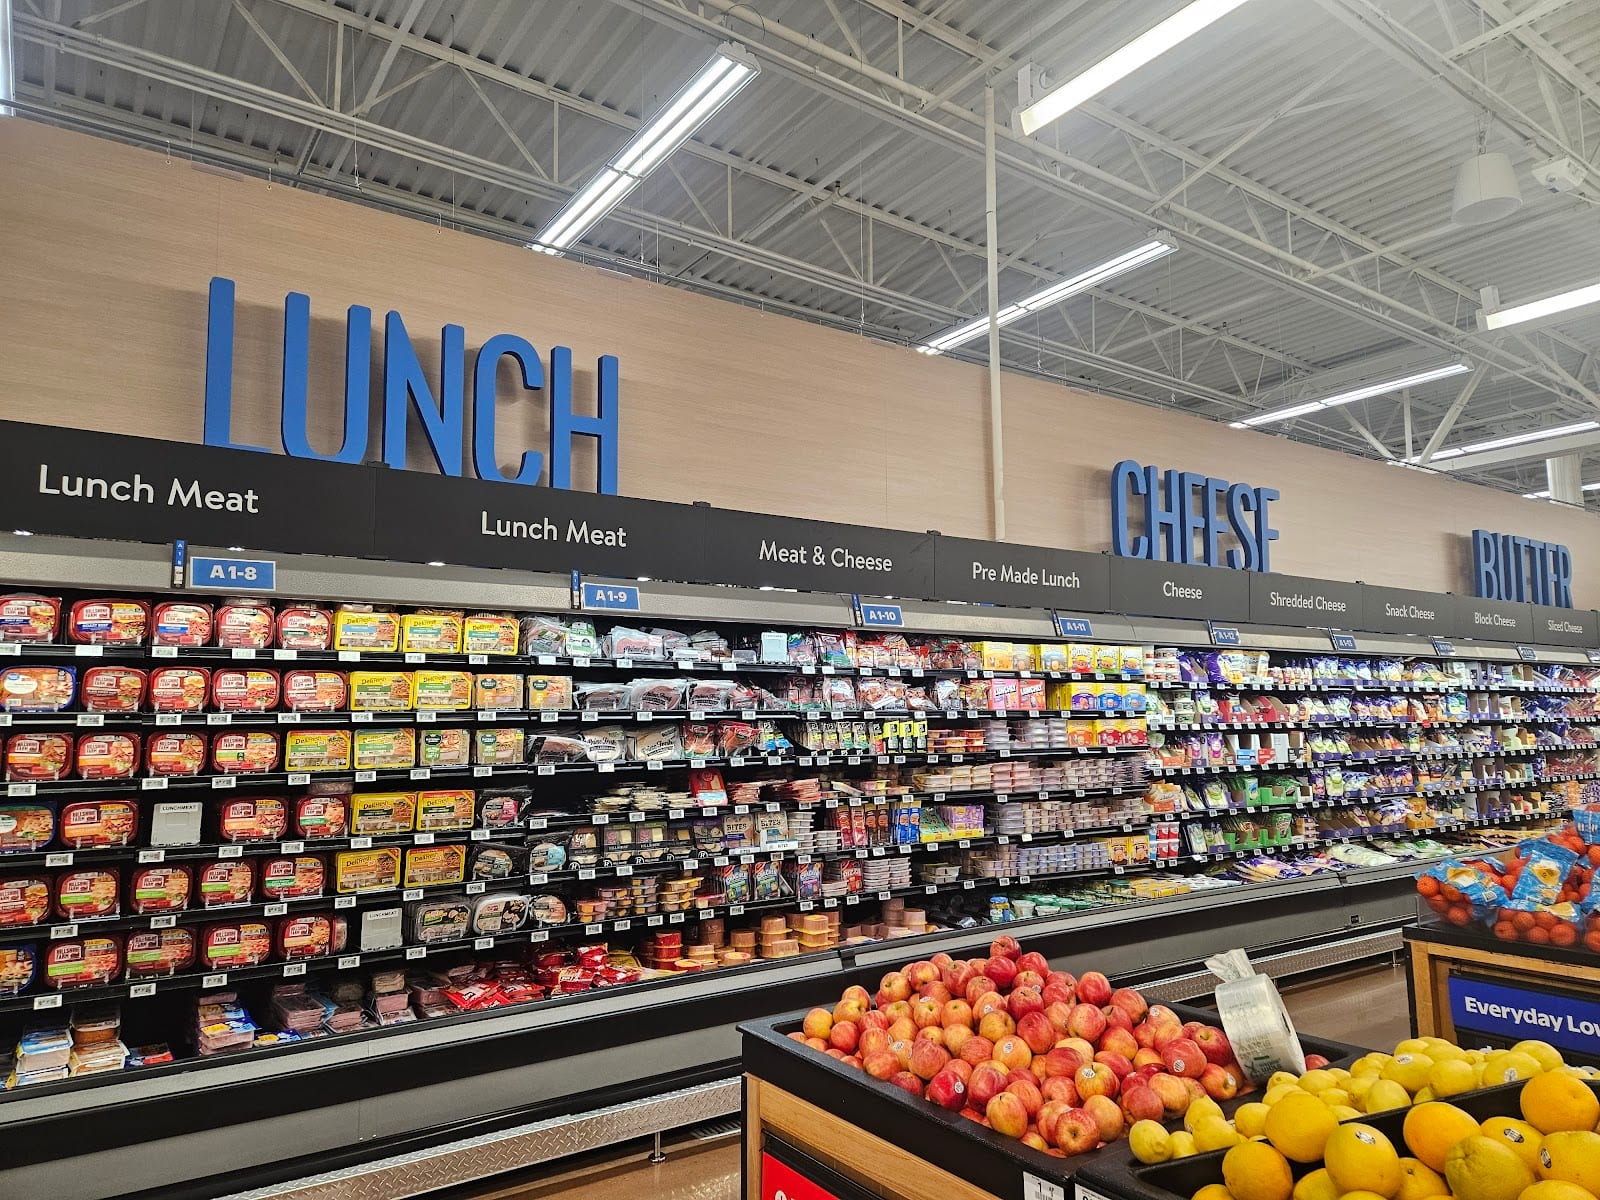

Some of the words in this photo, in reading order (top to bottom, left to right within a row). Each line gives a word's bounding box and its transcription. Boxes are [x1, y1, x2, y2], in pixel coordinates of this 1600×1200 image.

[204, 276, 618, 496] LUNCH
[39, 464, 154, 503] Lunch
[168, 478, 259, 513] Meat
[481, 511, 558, 541] Lunch
[566, 519, 627, 548] Meat
[1111, 459, 1280, 573] CHEESE
[759, 540, 806, 565] Meat
[812, 547, 825, 565] &
[831, 548, 892, 572] Cheese
[1472, 529, 1574, 609] BUTTER
[972, 562, 996, 581] Pre
[1000, 565, 1038, 585] Made
[1043, 569, 1080, 589] Lunch
[1163, 581, 1202, 600] Cheese
[1270, 591, 1313, 610] Shredded
[1316, 595, 1346, 612] Cheese
[869, 609, 896, 623] A1-10
[1385, 603, 1407, 618] Snack
[1409, 605, 1435, 621] Cheese
[1474, 612, 1492, 626] Block
[1494, 615, 1516, 628] Cheese
[1548, 620, 1563, 632] Sliced
[1564, 622, 1583, 634] Cheese
[1464, 996, 1563, 1032] Everyday
